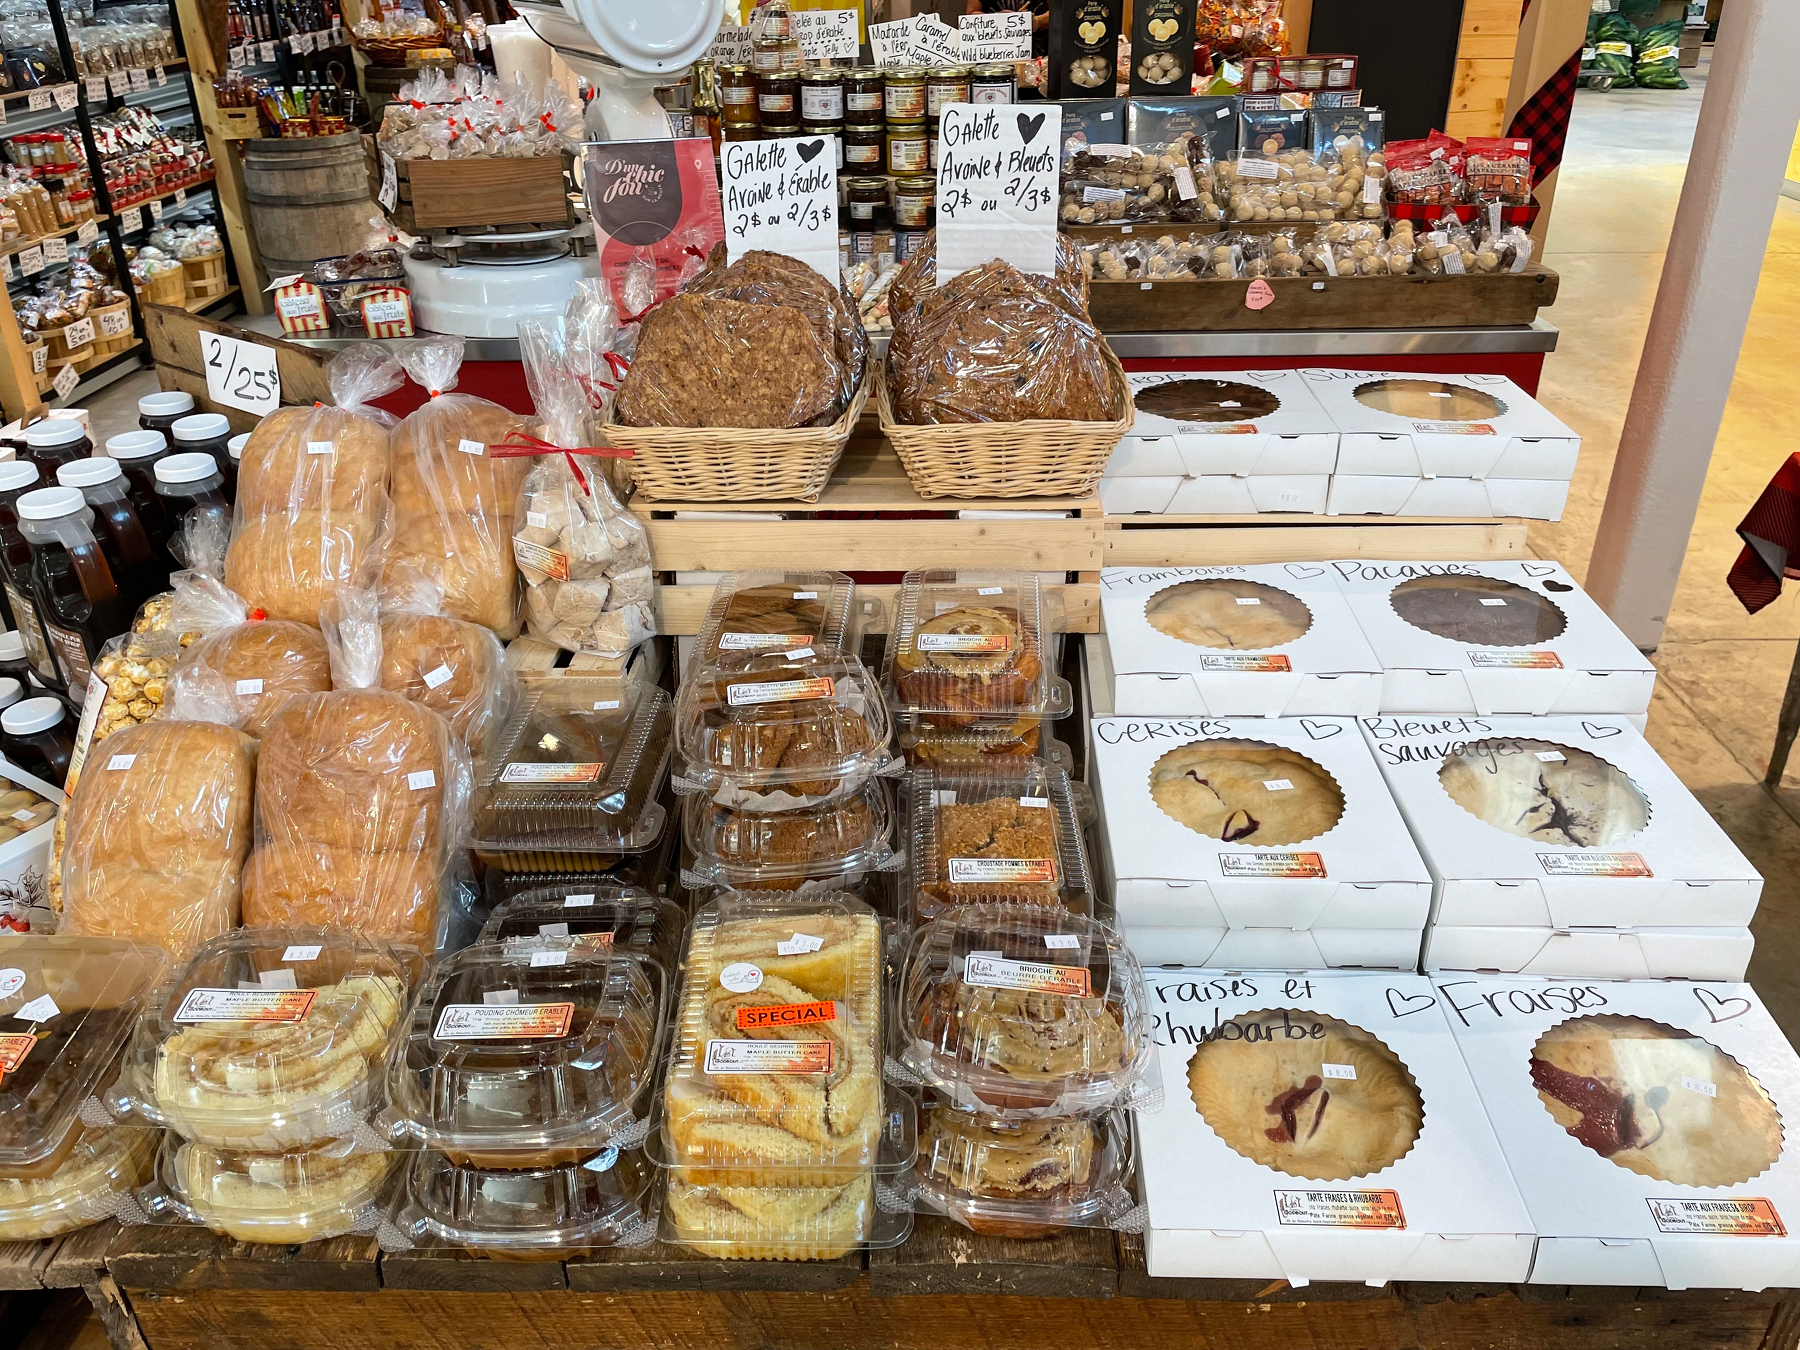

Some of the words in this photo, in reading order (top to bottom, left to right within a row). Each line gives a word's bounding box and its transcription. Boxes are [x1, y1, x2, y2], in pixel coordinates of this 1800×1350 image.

[816, 15, 826, 26] au
[1007, 15, 1026, 28] 5$
[1008, 145, 1054, 173] Bleuets
[625, 164, 665, 183] chic
[981, 199, 996, 211] ou
[768, 213, 780, 226] ou
[1302, 369, 1398, 382] Sucre
[1100, 564, 1246, 591] Framboises
[1362, 717, 1493, 741] Bleuets
[1000, 971, 1037, 980] BEURRE
[1020, 966, 1053, 975] BRIOCHE
[1145, 978, 1258, 1004] raises
[1281, 978, 1317, 999] et
[1438, 981, 1608, 1027] Fraises
[746, 1007, 828, 1024] SPECIAL
[1306, 1193, 1323, 1203] TARTE
[1324, 1193, 1347, 1203] FRAISES
[1353, 1194, 1384, 1204] RHUBARBE
[1680, 1202, 1699, 1212] TARTE
[1700, 1202, 1712, 1212] AUX
